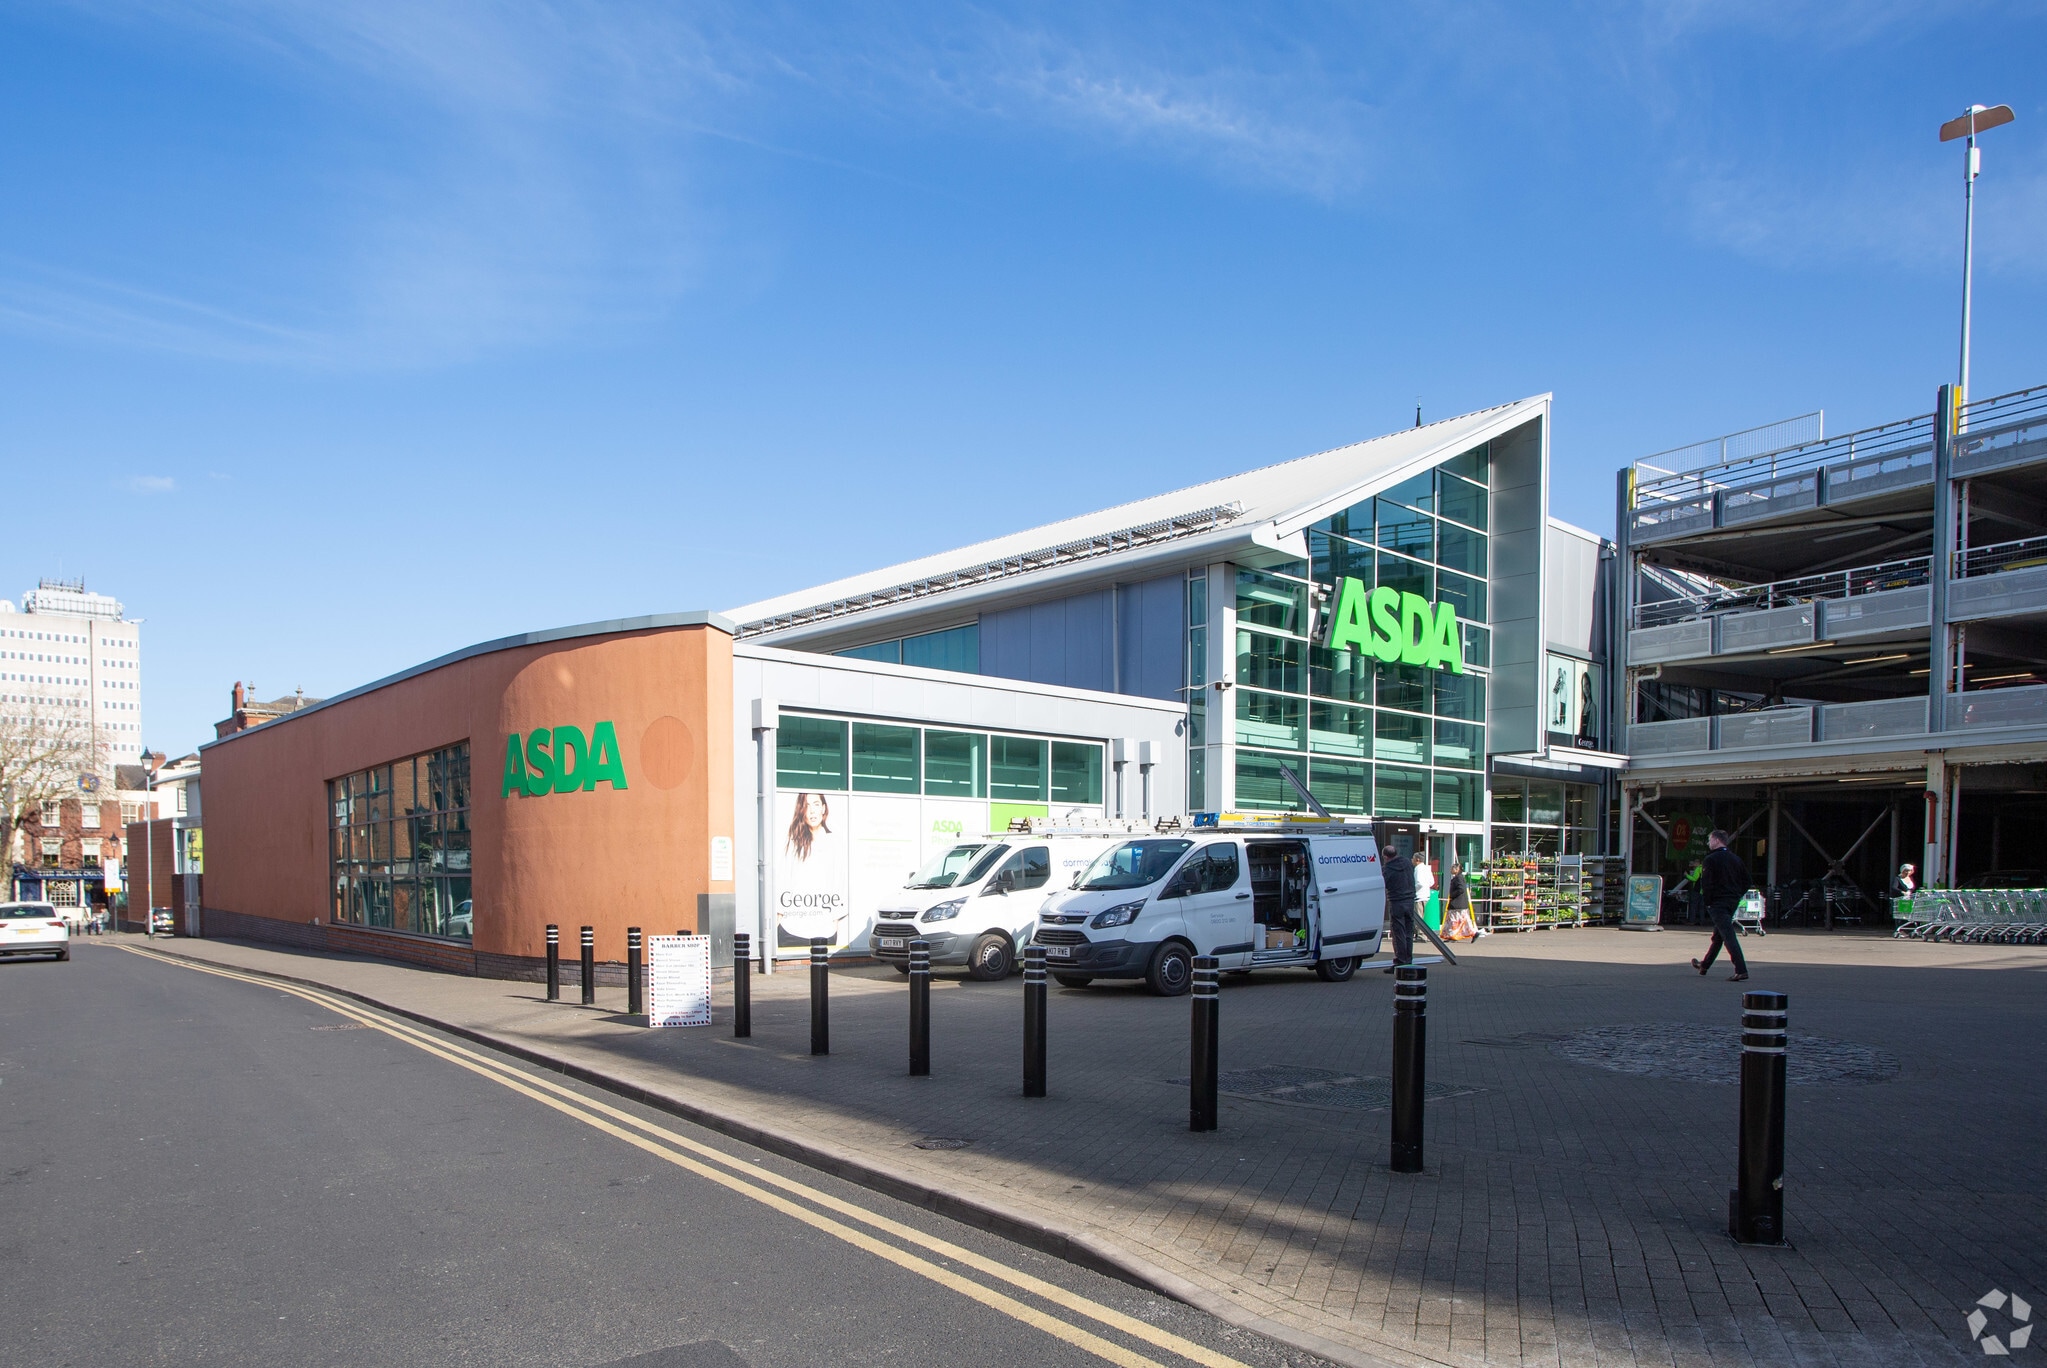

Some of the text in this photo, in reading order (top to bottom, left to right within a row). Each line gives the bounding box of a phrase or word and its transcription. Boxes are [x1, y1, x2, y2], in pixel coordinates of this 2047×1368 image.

[1329, 576, 1463, 675] ASDA
[501, 720, 629, 799] ASDA
[932, 820, 964, 833] ASDA
[1318, 854, 1367, 865] dormakaba
[780, 891, 844, 913] George.
